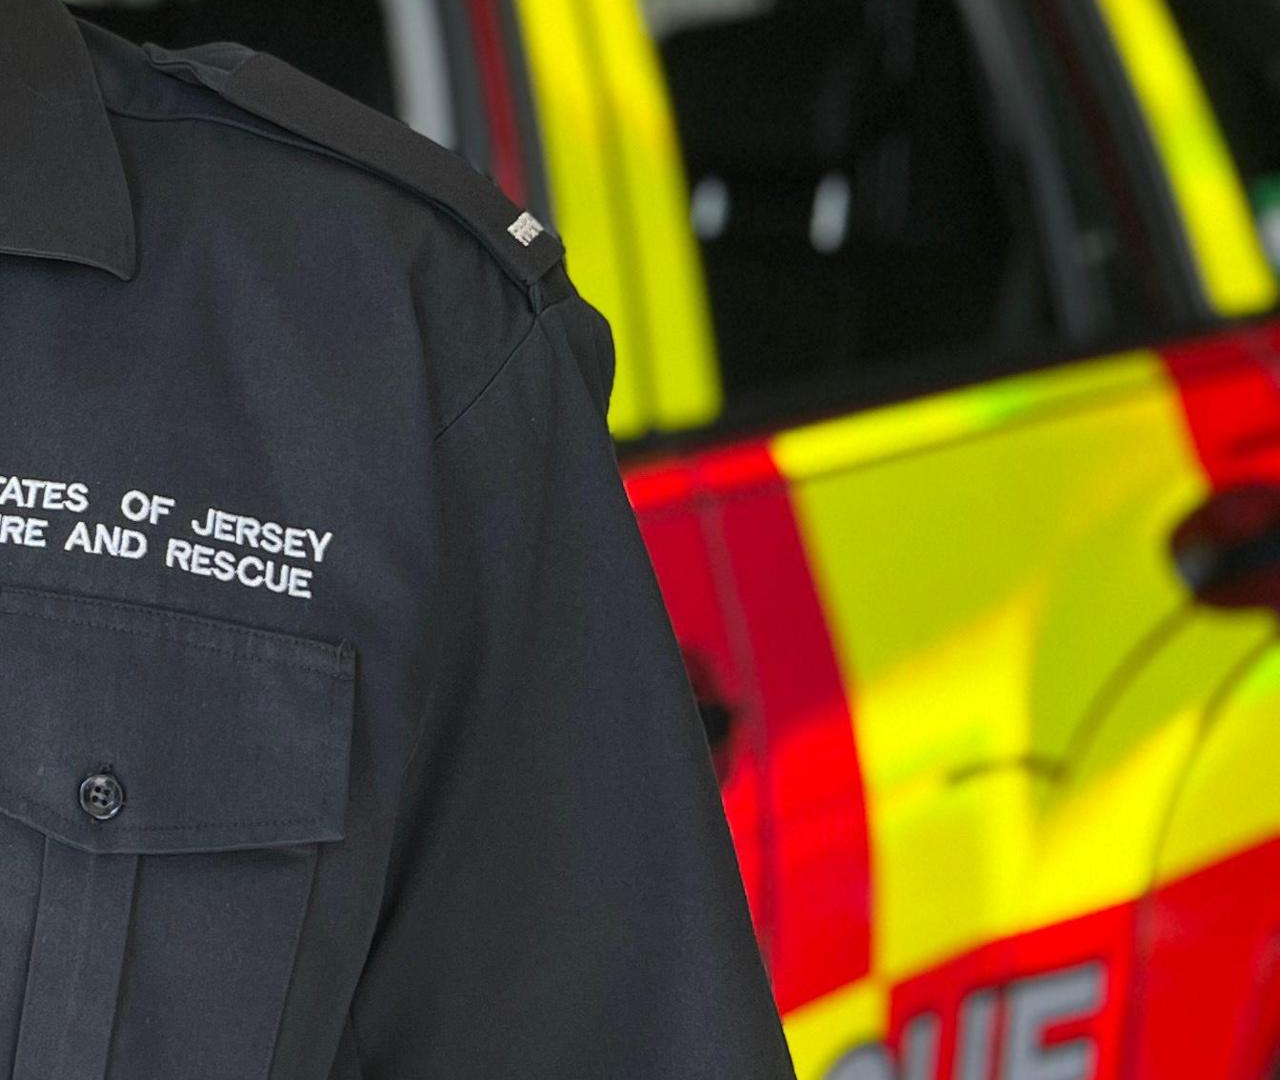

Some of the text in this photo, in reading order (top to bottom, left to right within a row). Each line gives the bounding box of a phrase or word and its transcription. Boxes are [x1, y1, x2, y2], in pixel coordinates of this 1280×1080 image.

[63, 521, 149, 560] AND
[165, 537, 314, 599] RESCUE
[120, 489, 176, 525] OF
[191, 508, 333, 563] JERSEY
